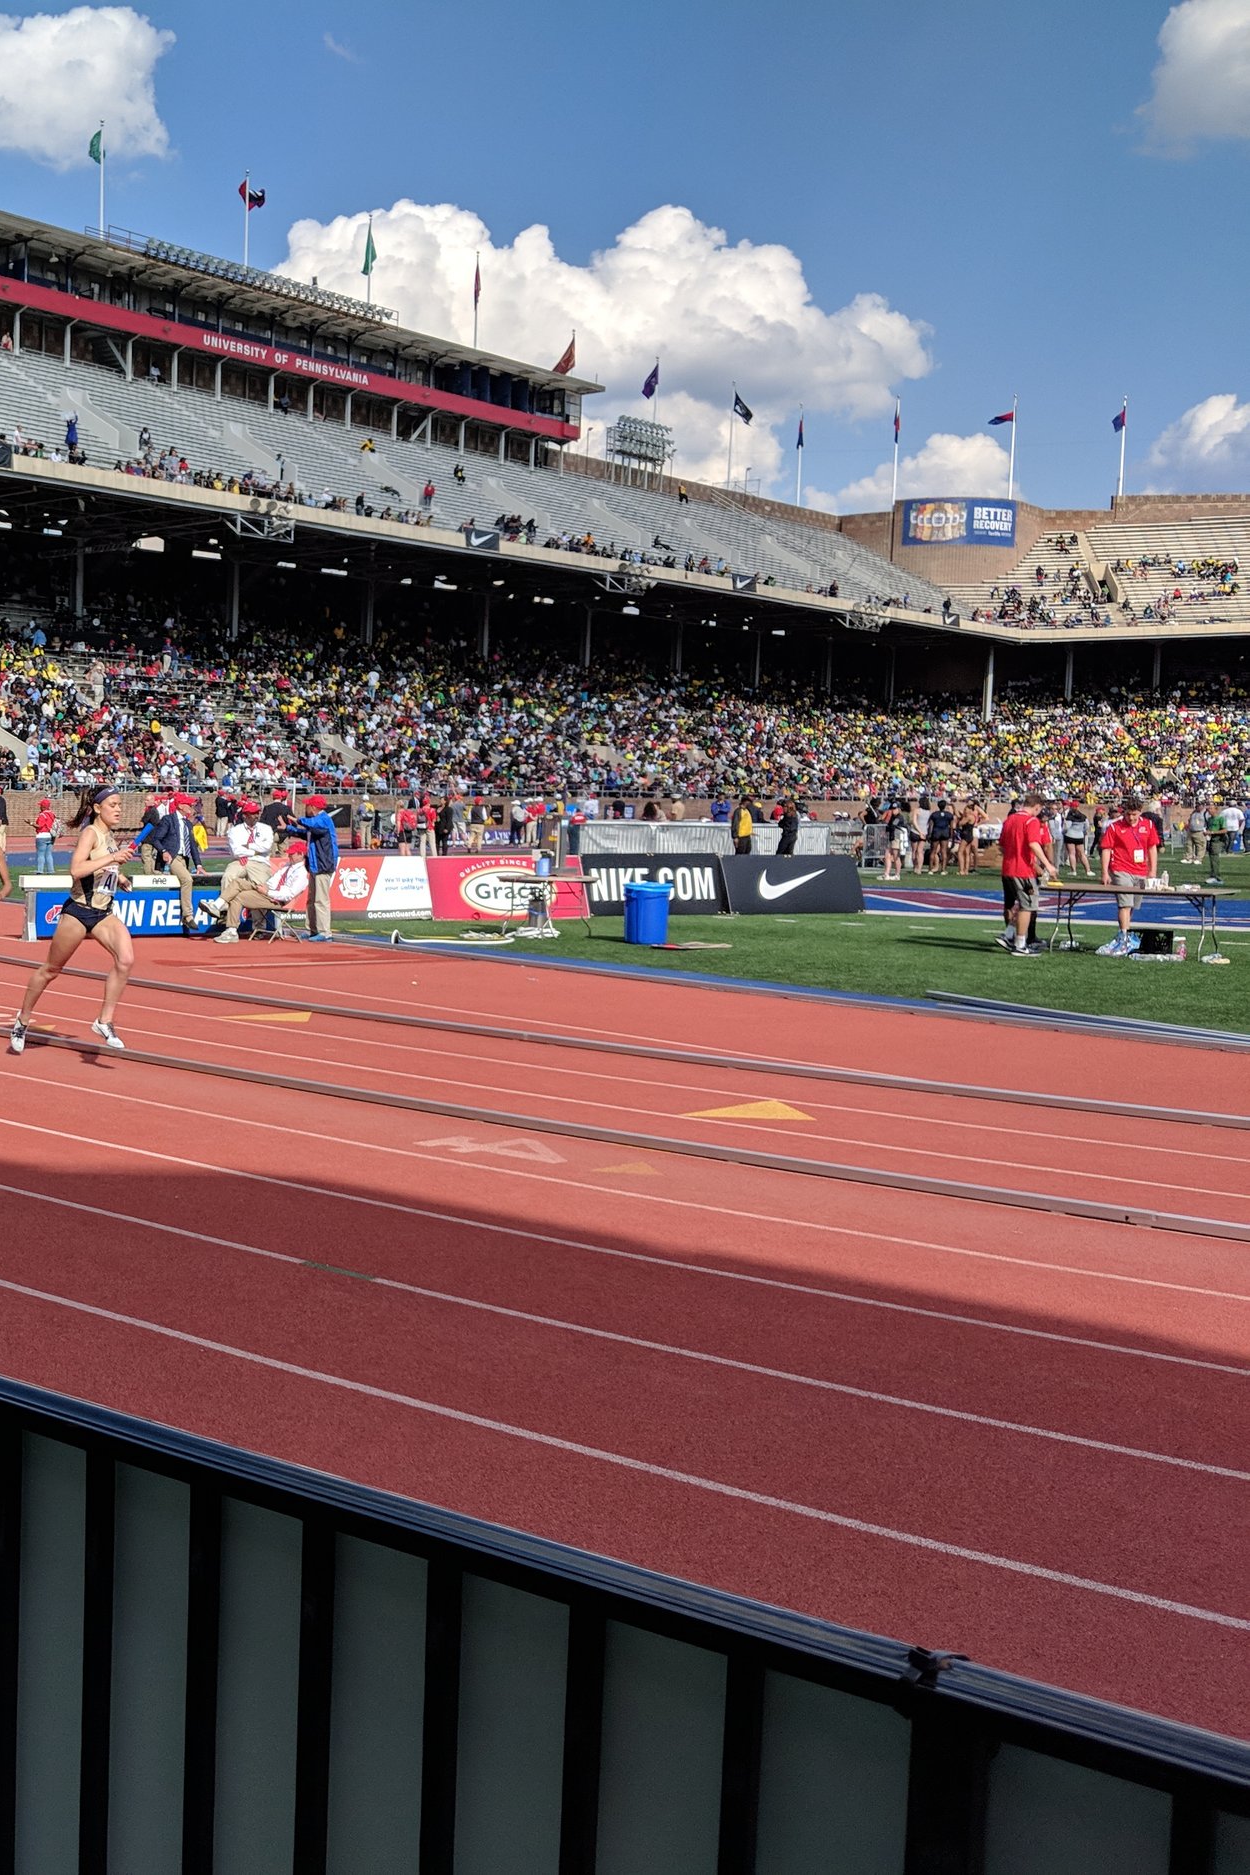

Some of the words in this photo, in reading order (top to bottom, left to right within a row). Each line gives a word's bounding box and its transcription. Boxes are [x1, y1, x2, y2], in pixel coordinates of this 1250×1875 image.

[203, 334, 268, 360] UNIVERSITY
[275, 352, 289, 365] OF
[296, 358, 369, 386] PENNSYLVANIA
[973, 506, 1013, 522] BETTER
[973, 519, 1013, 532] RECOVERY
[460, 860, 496, 878] QUALITY
[499, 859, 528, 867] SINCE
[589, 866, 716, 902] NIKECOM
[111, 899, 146, 927] NN
[367, 910, 432, 919] GoCoastGuard.com
[412, 1135, 568, 1164] 4
